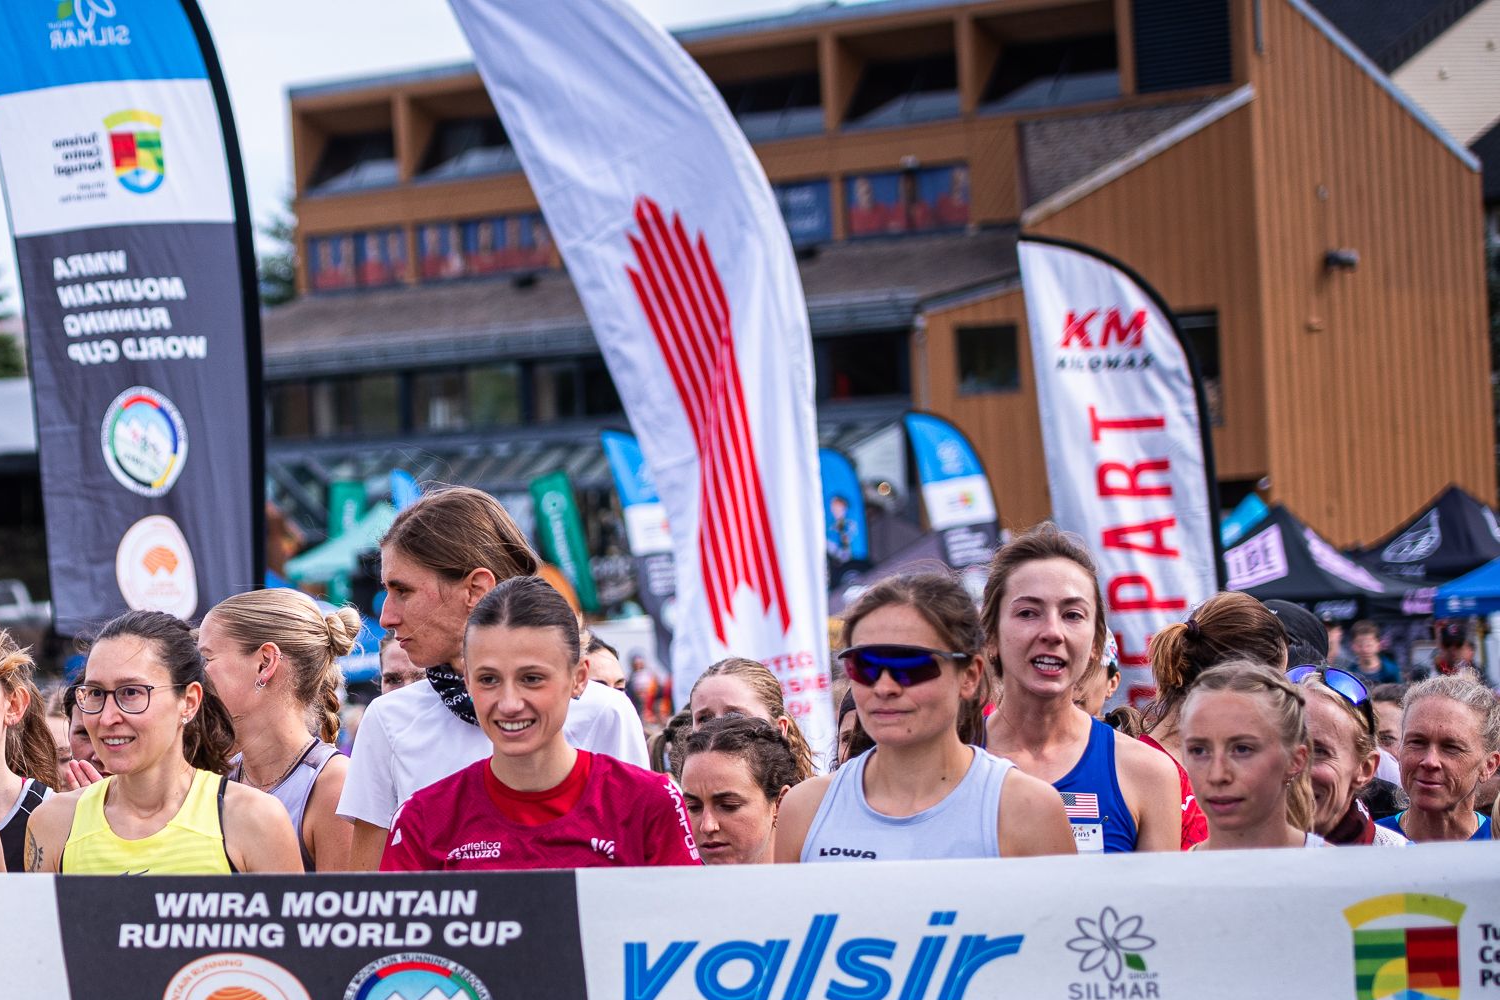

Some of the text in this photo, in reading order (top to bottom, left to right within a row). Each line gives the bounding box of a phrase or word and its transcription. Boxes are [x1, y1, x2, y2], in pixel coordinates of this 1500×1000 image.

[1060, 308, 1148, 348] KM
[455, 849, 501, 860] SALUZZO
[819, 847, 877, 860] LOWA
[155, 889, 478, 918] WMRA MOUNTAIN
[118, 920, 522, 949] RUNNING WORLD CUP
[1068, 982, 1160, 1000] SILMAR
